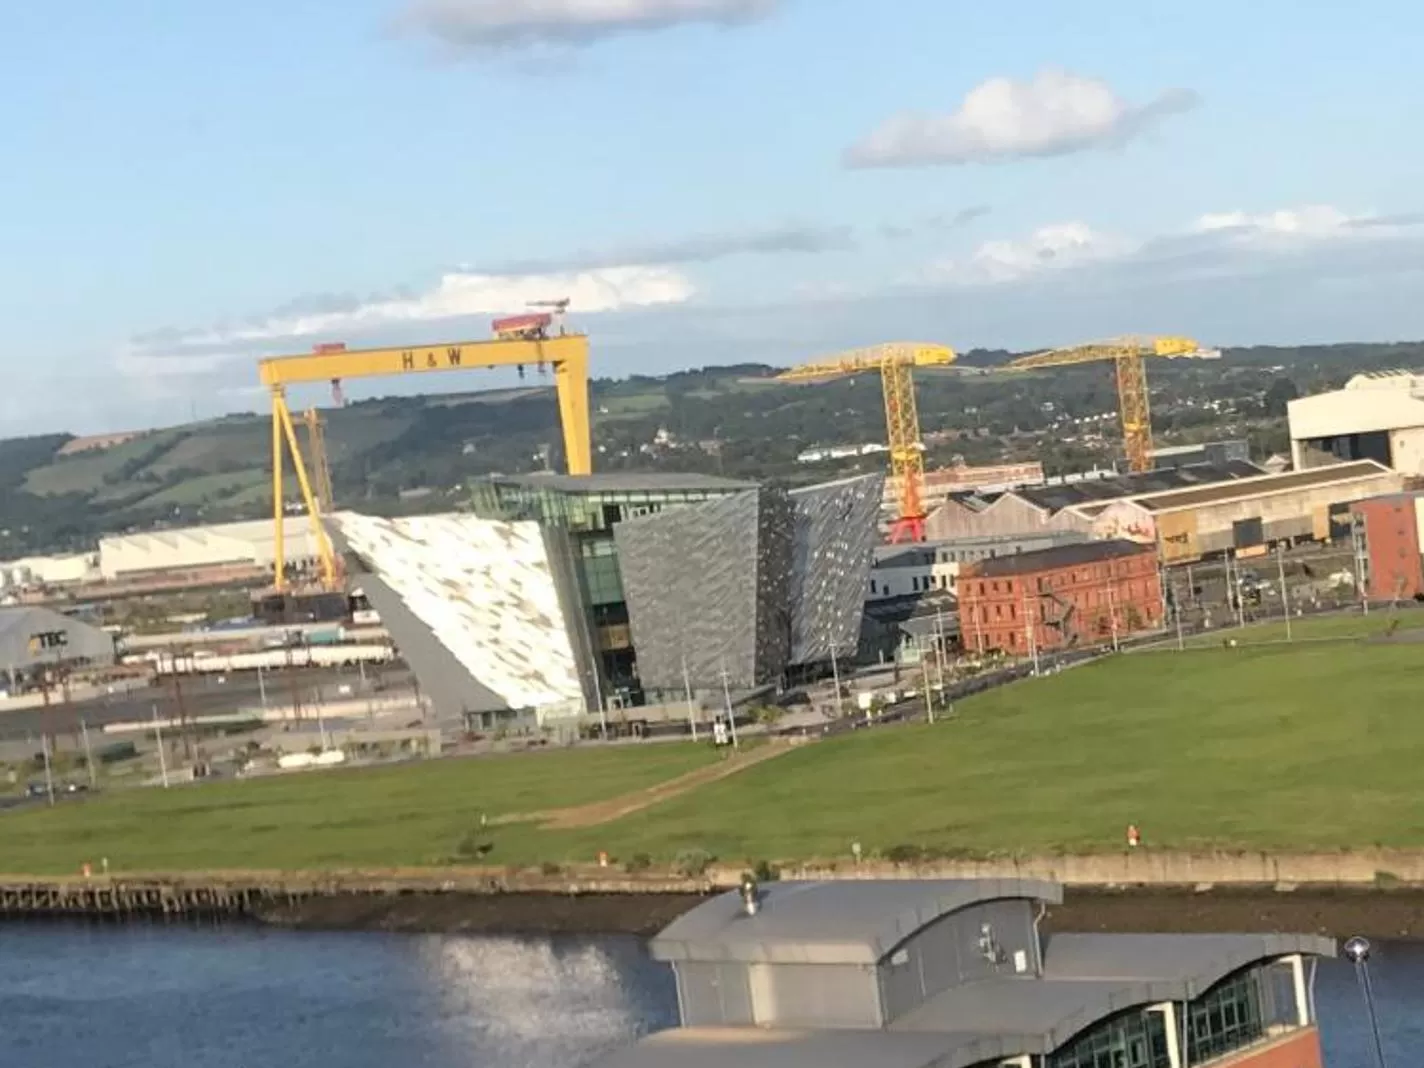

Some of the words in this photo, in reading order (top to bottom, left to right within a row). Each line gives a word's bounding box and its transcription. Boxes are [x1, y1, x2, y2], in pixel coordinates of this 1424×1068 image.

[402, 351, 413, 370] H
[427, 353, 437, 367] &
[448, 349, 461, 366] W
